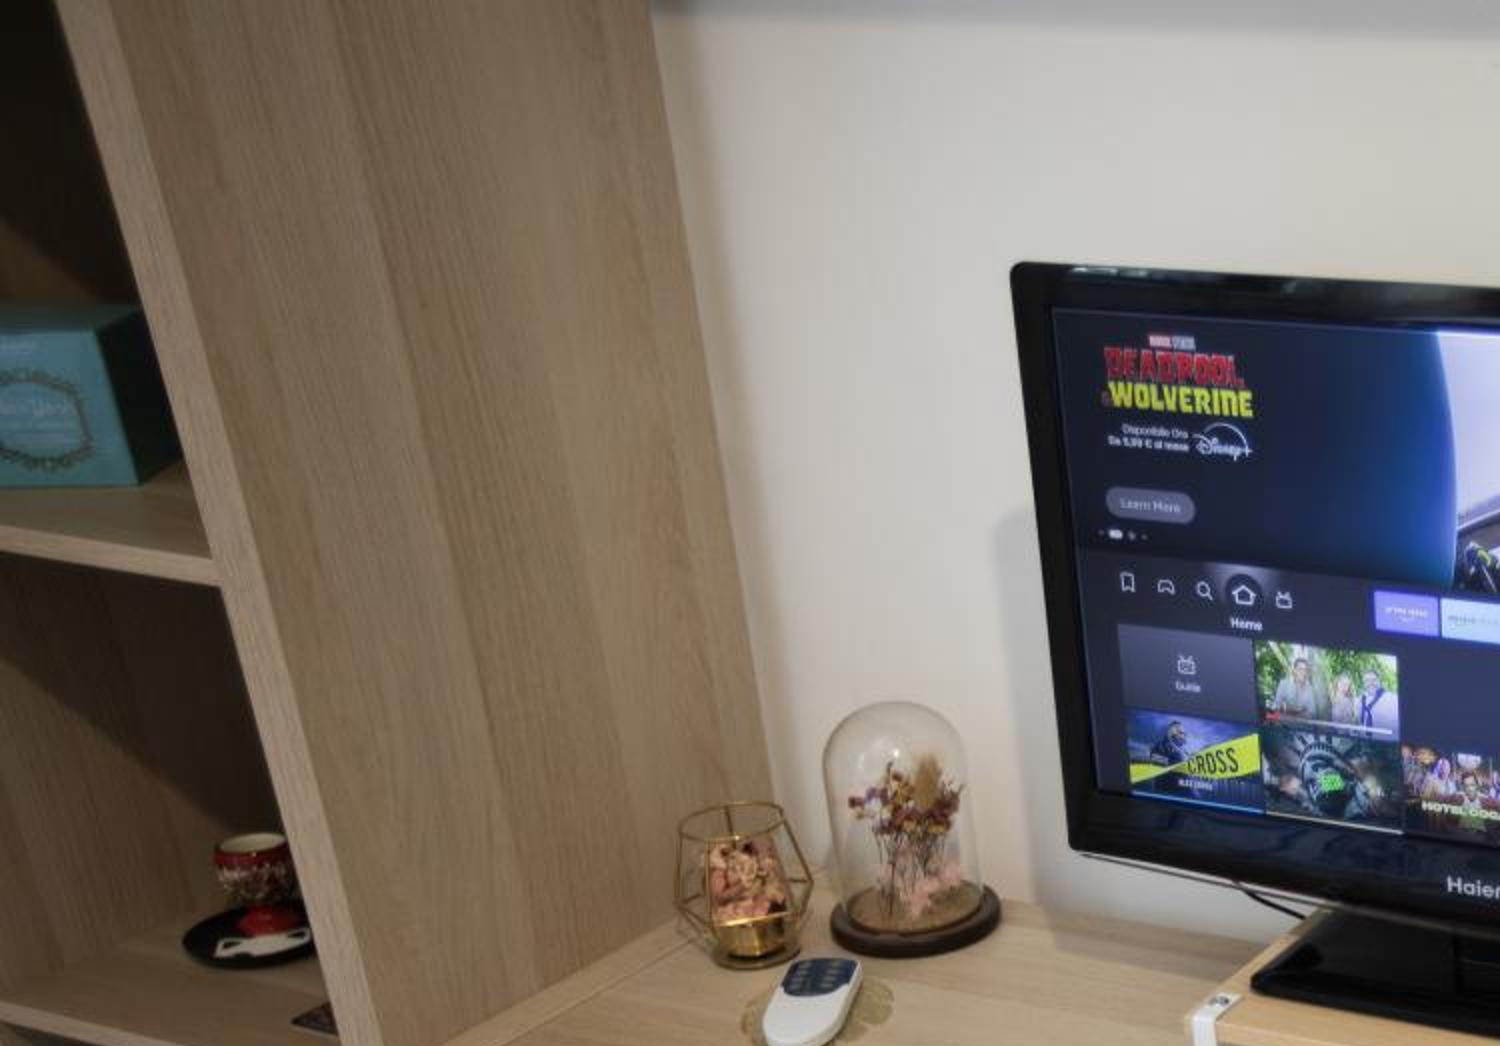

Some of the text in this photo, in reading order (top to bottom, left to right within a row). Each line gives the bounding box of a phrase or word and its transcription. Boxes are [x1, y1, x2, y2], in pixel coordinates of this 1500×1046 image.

[1104, 347, 1245, 388] DEADPOOL
[1107, 381, 1254, 418] WOLVERINE
[1120, 498, 1181, 513] Learn More
[1231, 616, 1263, 631] Home
[1187, 747, 1239, 774] CROSS
[1421, 801, 1467, 816] HOTEL
